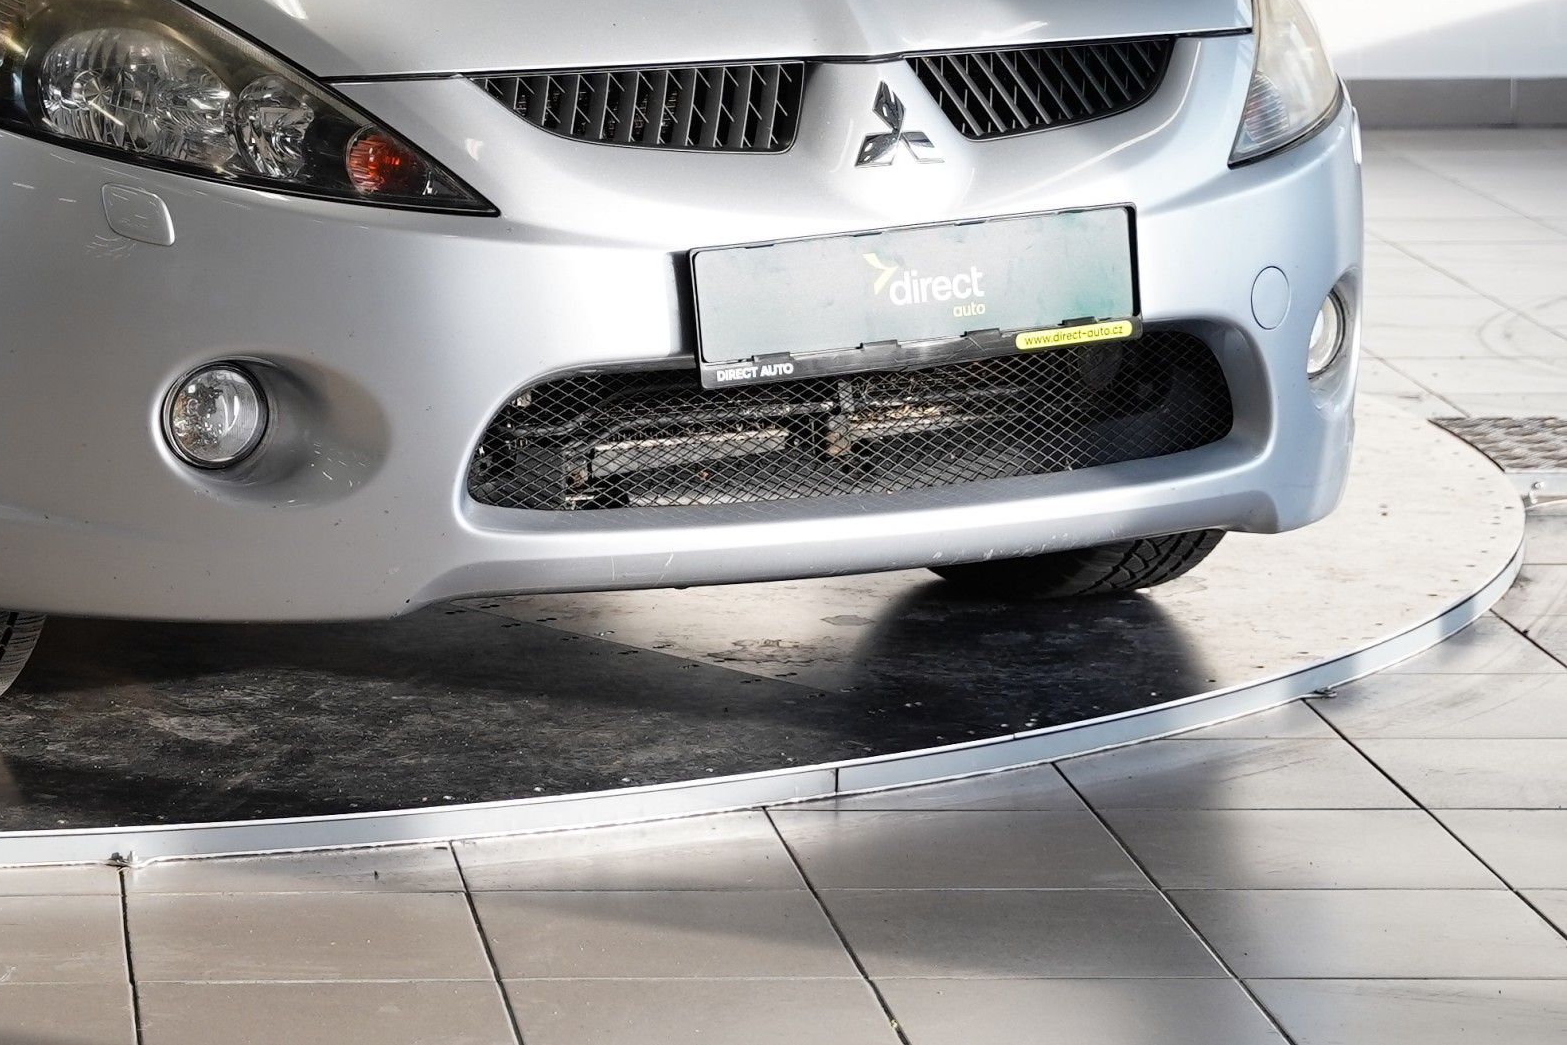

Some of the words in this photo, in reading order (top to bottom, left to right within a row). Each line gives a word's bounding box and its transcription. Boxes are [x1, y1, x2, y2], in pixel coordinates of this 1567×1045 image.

[889, 266, 985, 306] direct
[952, 302, 986, 318] auto
[1024, 325, 1124, 346] www.direct-auto.cz
[716, 366, 758, 382] DIRECT
[760, 362, 794, 377] AUTO
